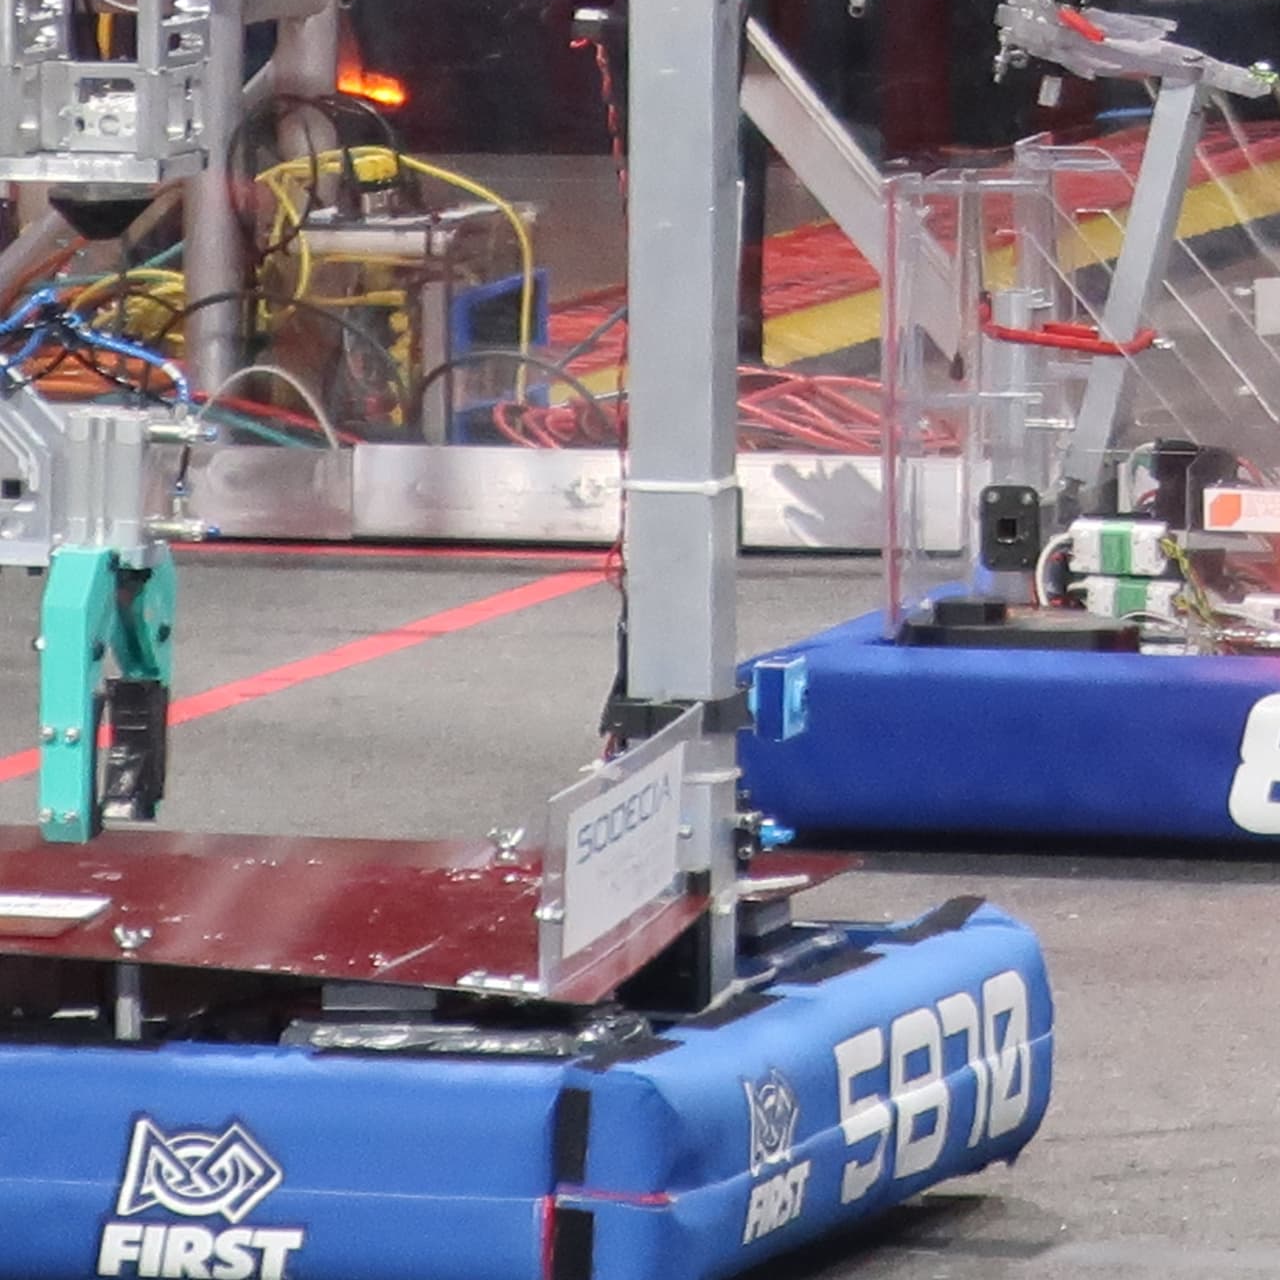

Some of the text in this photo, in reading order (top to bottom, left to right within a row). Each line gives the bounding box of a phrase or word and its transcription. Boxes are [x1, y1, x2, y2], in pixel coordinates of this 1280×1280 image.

[834, 970, 1032, 1204] 5870
[743, 1160, 810, 1245] FIRST
[98, 1223, 304, 1280] FIRST
